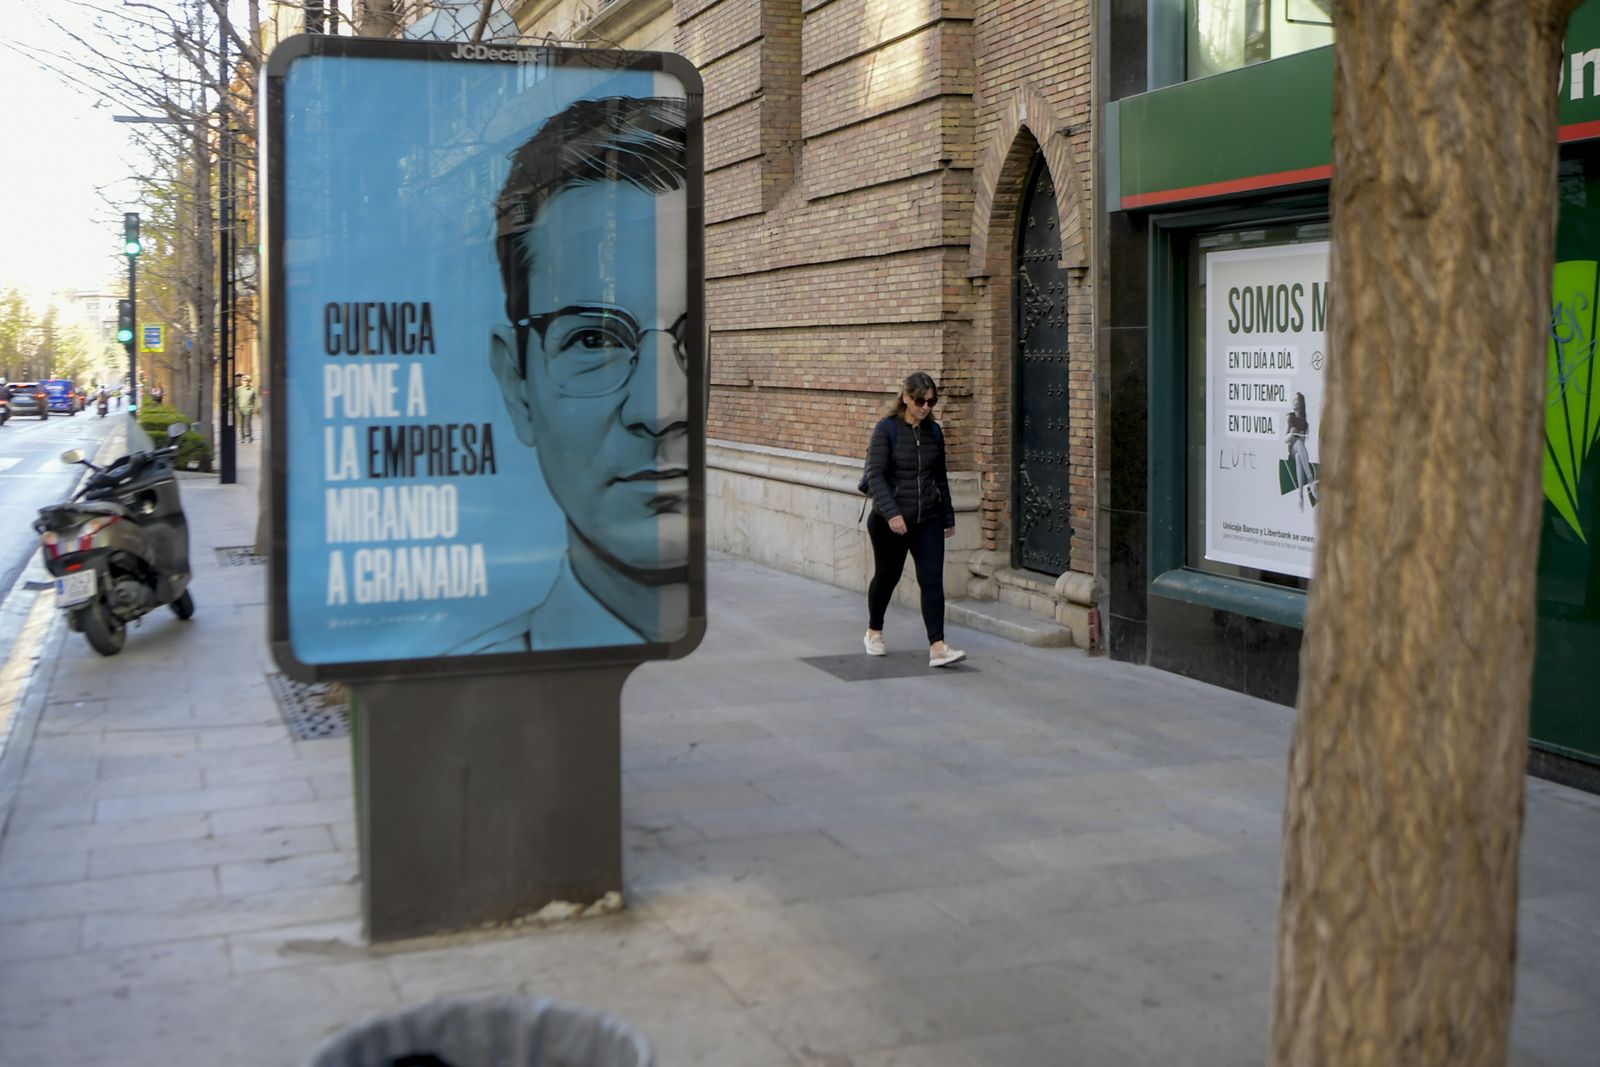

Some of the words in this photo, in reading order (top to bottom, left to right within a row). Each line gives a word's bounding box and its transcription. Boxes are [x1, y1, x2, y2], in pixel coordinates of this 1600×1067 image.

[451, 44, 538, 62] JCDecaux
[324, 302, 436, 357] CUENCA
[1228, 283, 1304, 334] SOMOS
[1311, 281, 1329, 333] M
[1229, 352, 1240, 369] EN
[1241, 352, 1252, 369] TU
[1254, 347, 1268, 369] DÍA
[1269, 352, 1275, 369] A
[1277, 347, 1295, 369] DÍA.
[324, 364, 400, 419] PONE
[406, 363, 428, 417] A
[1229, 383, 1240, 401] EN
[1241, 383, 1252, 401] TU
[1253, 384, 1287, 402] TIEMPO.
[1229, 415, 1240, 432] EN
[1241, 415, 1252, 433] TU
[1253, 415, 1276, 434] VIDA.
[324, 425, 361, 481] LA
[367, 423, 497, 479] EMPRESA
[325, 484, 458, 543] MIRANDO
[326, 550, 349, 606] A
[354, 543, 488, 604] GRANADA
